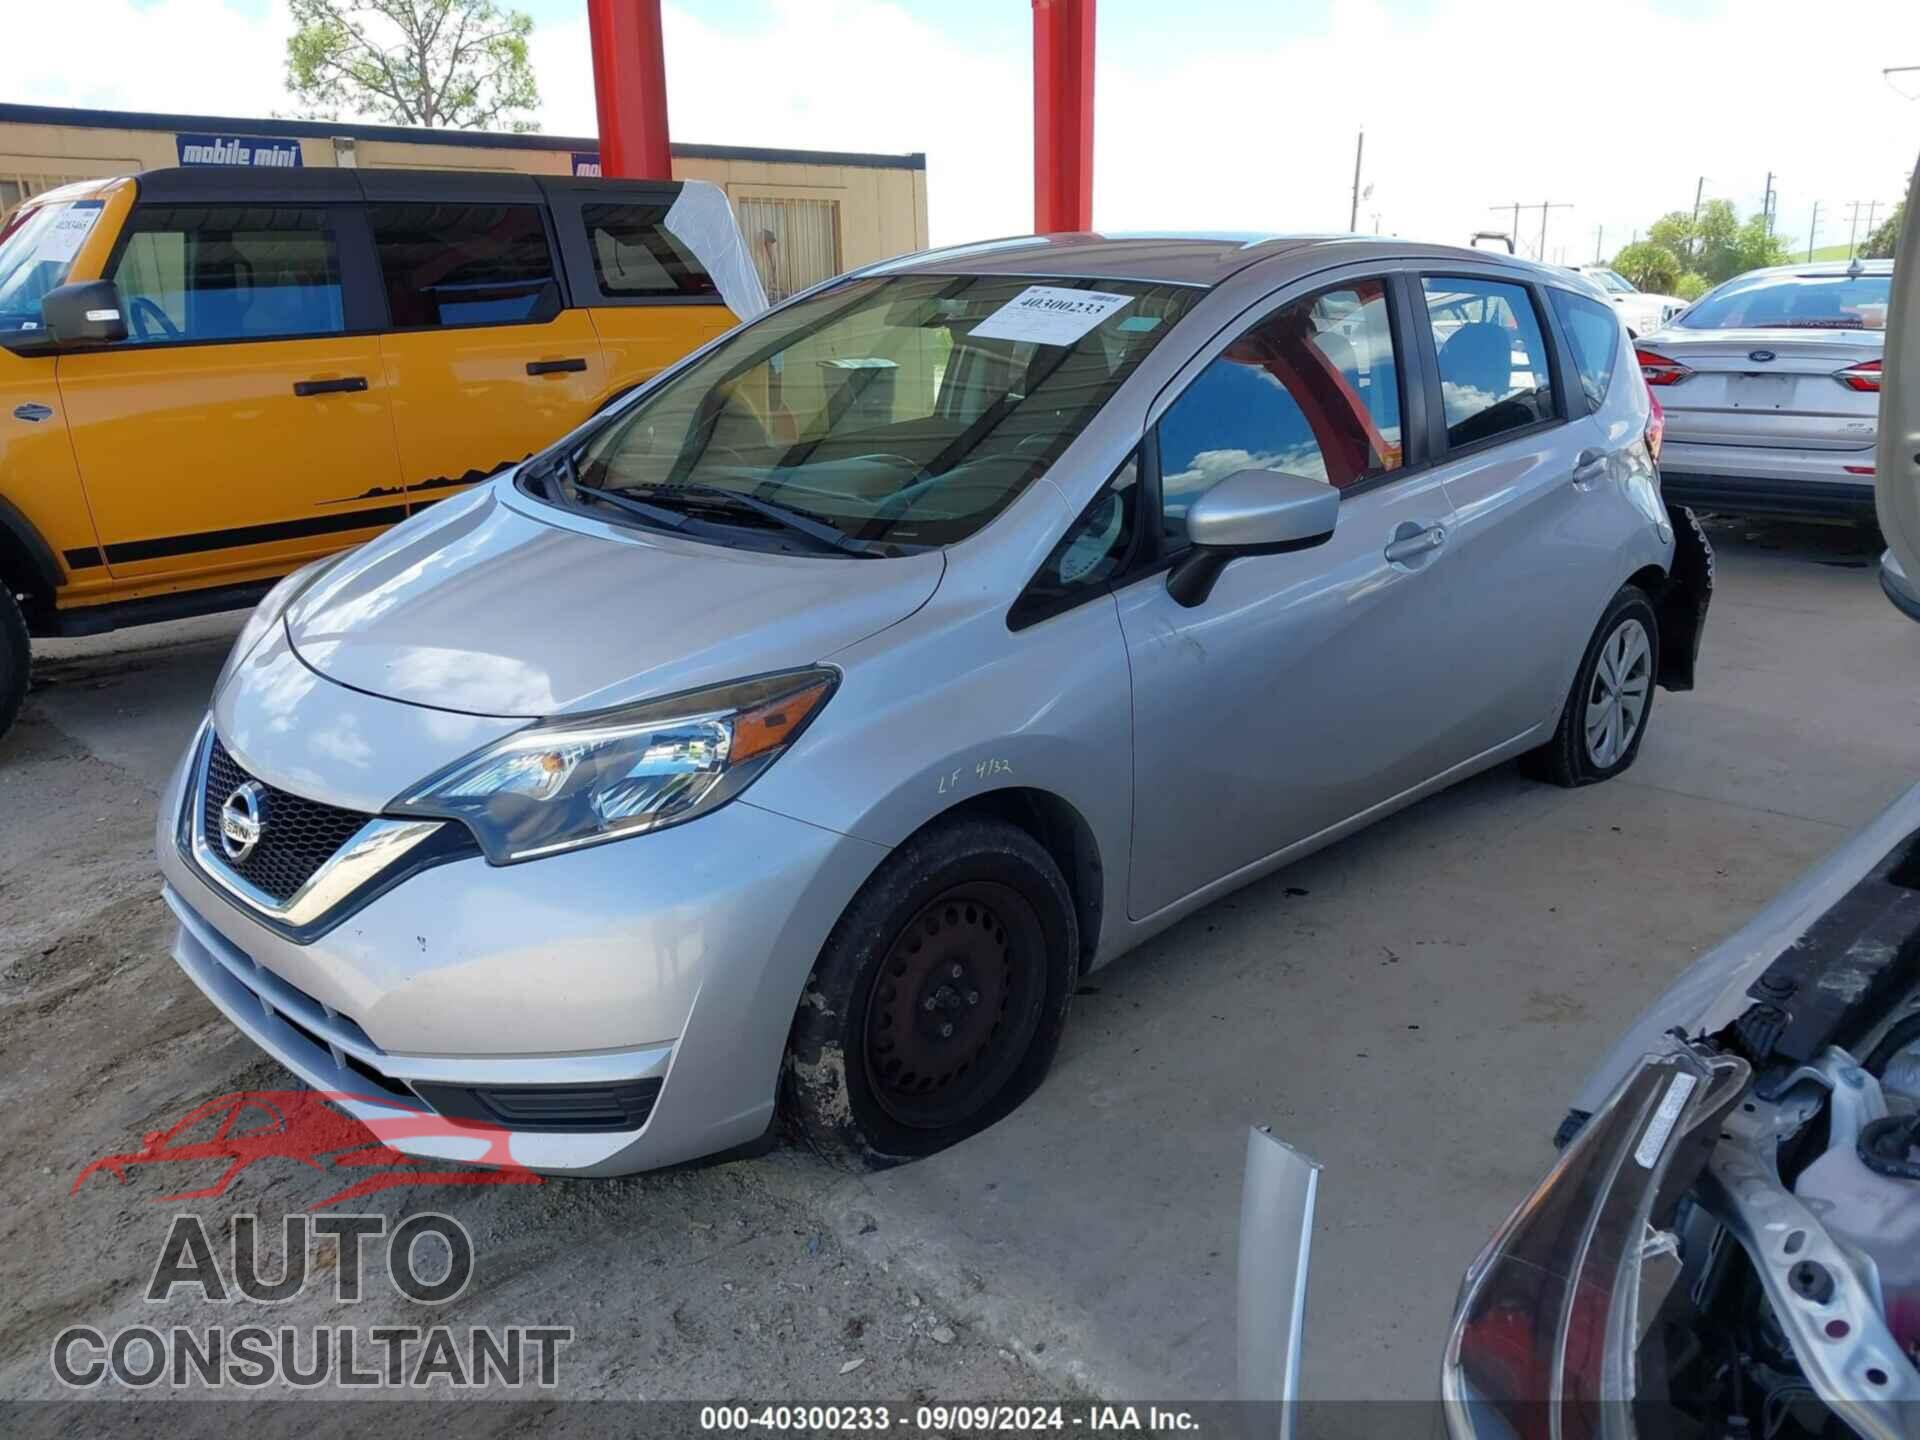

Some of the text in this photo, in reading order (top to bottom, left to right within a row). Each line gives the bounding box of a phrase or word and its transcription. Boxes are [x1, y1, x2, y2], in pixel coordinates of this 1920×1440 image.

[183, 138, 296, 168] mobile mini
[1020, 297, 1104, 315] 40300233
